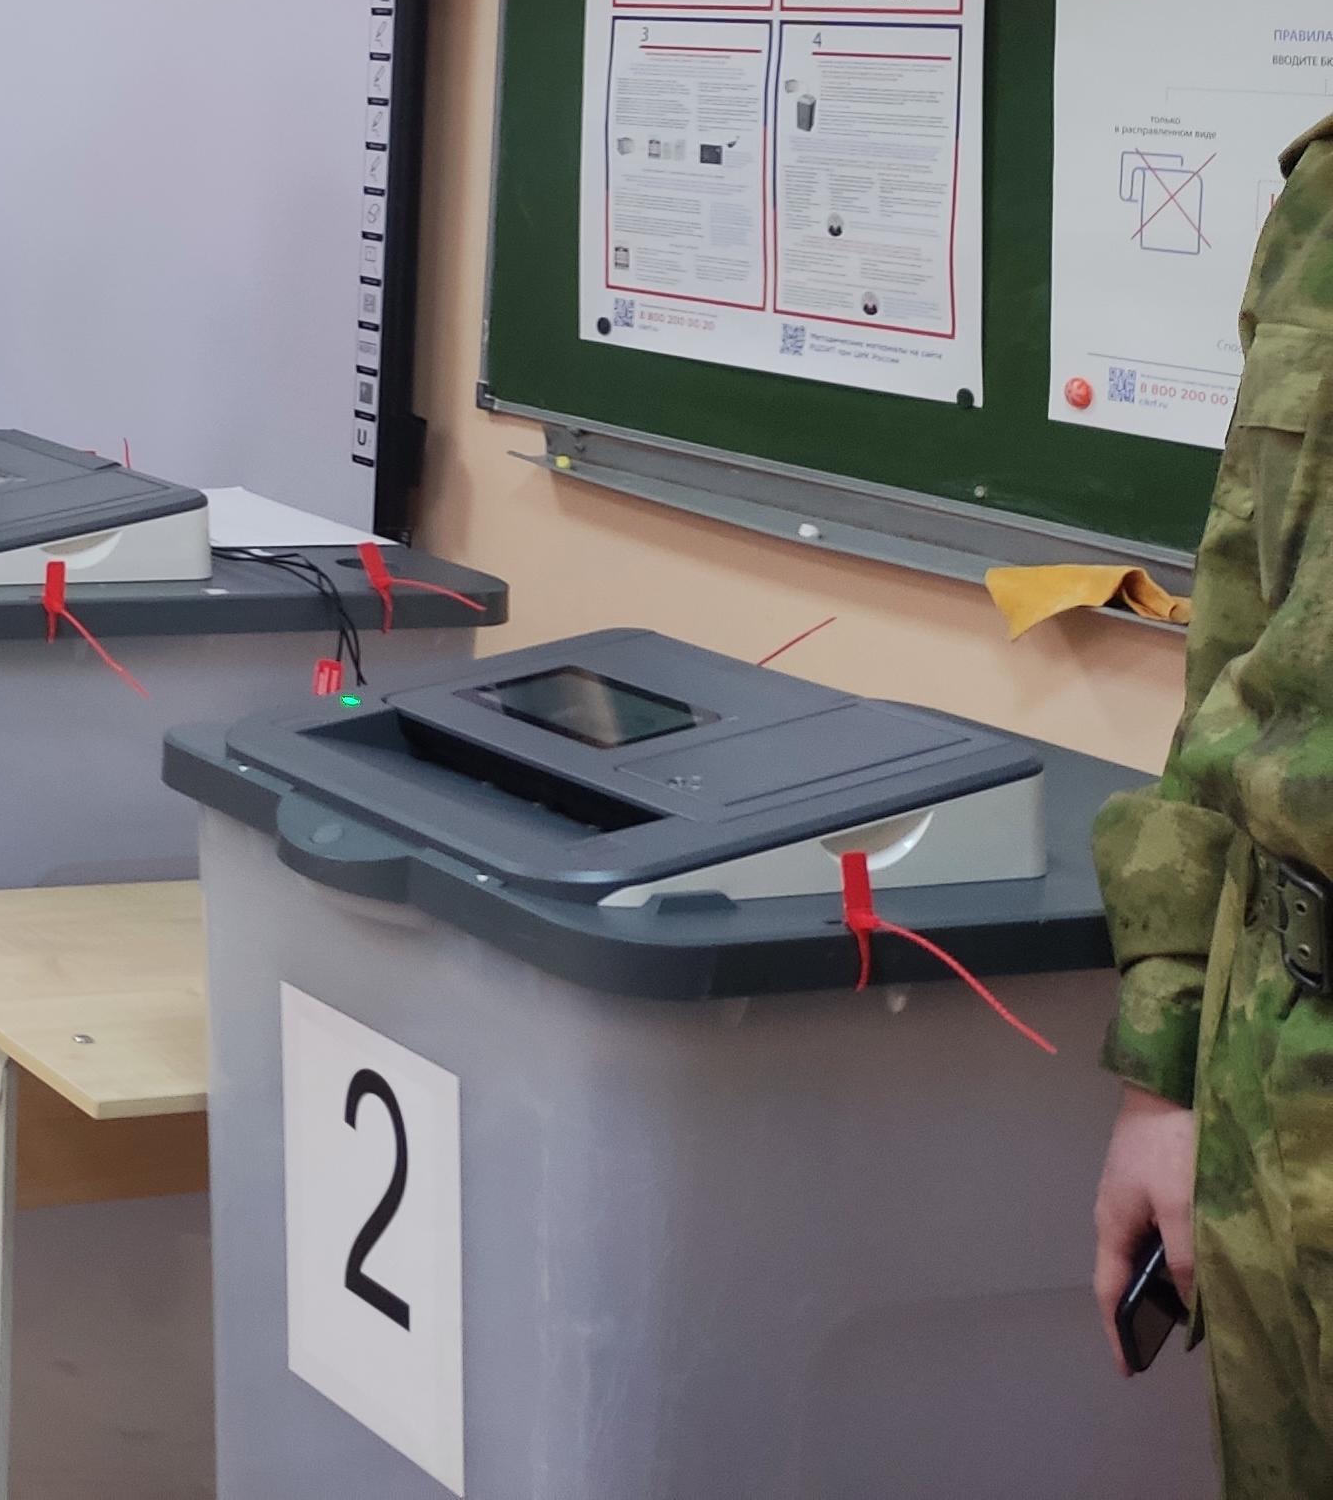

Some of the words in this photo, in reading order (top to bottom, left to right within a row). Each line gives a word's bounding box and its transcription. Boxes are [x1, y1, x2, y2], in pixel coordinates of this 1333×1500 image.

[640, 27, 650, 43] 3
[812, 31, 823, 48] 4
[1273, 29, 1333, 43] ПРАВИЛА
[1272, 55, 1318, 67] ВВОДИТЕ
[1150, 116, 1182, 125] только
[1121, 126, 1193, 138] расправленном
[1195, 131, 1218, 140] виде
[1140, 382, 1148, 394] 8
[1151, 383, 1177, 398] 800
[1181, 387, 1206, 402] 200
[1210, 392, 1229, 406] 00
[344, 1068, 410, 1332] 2
